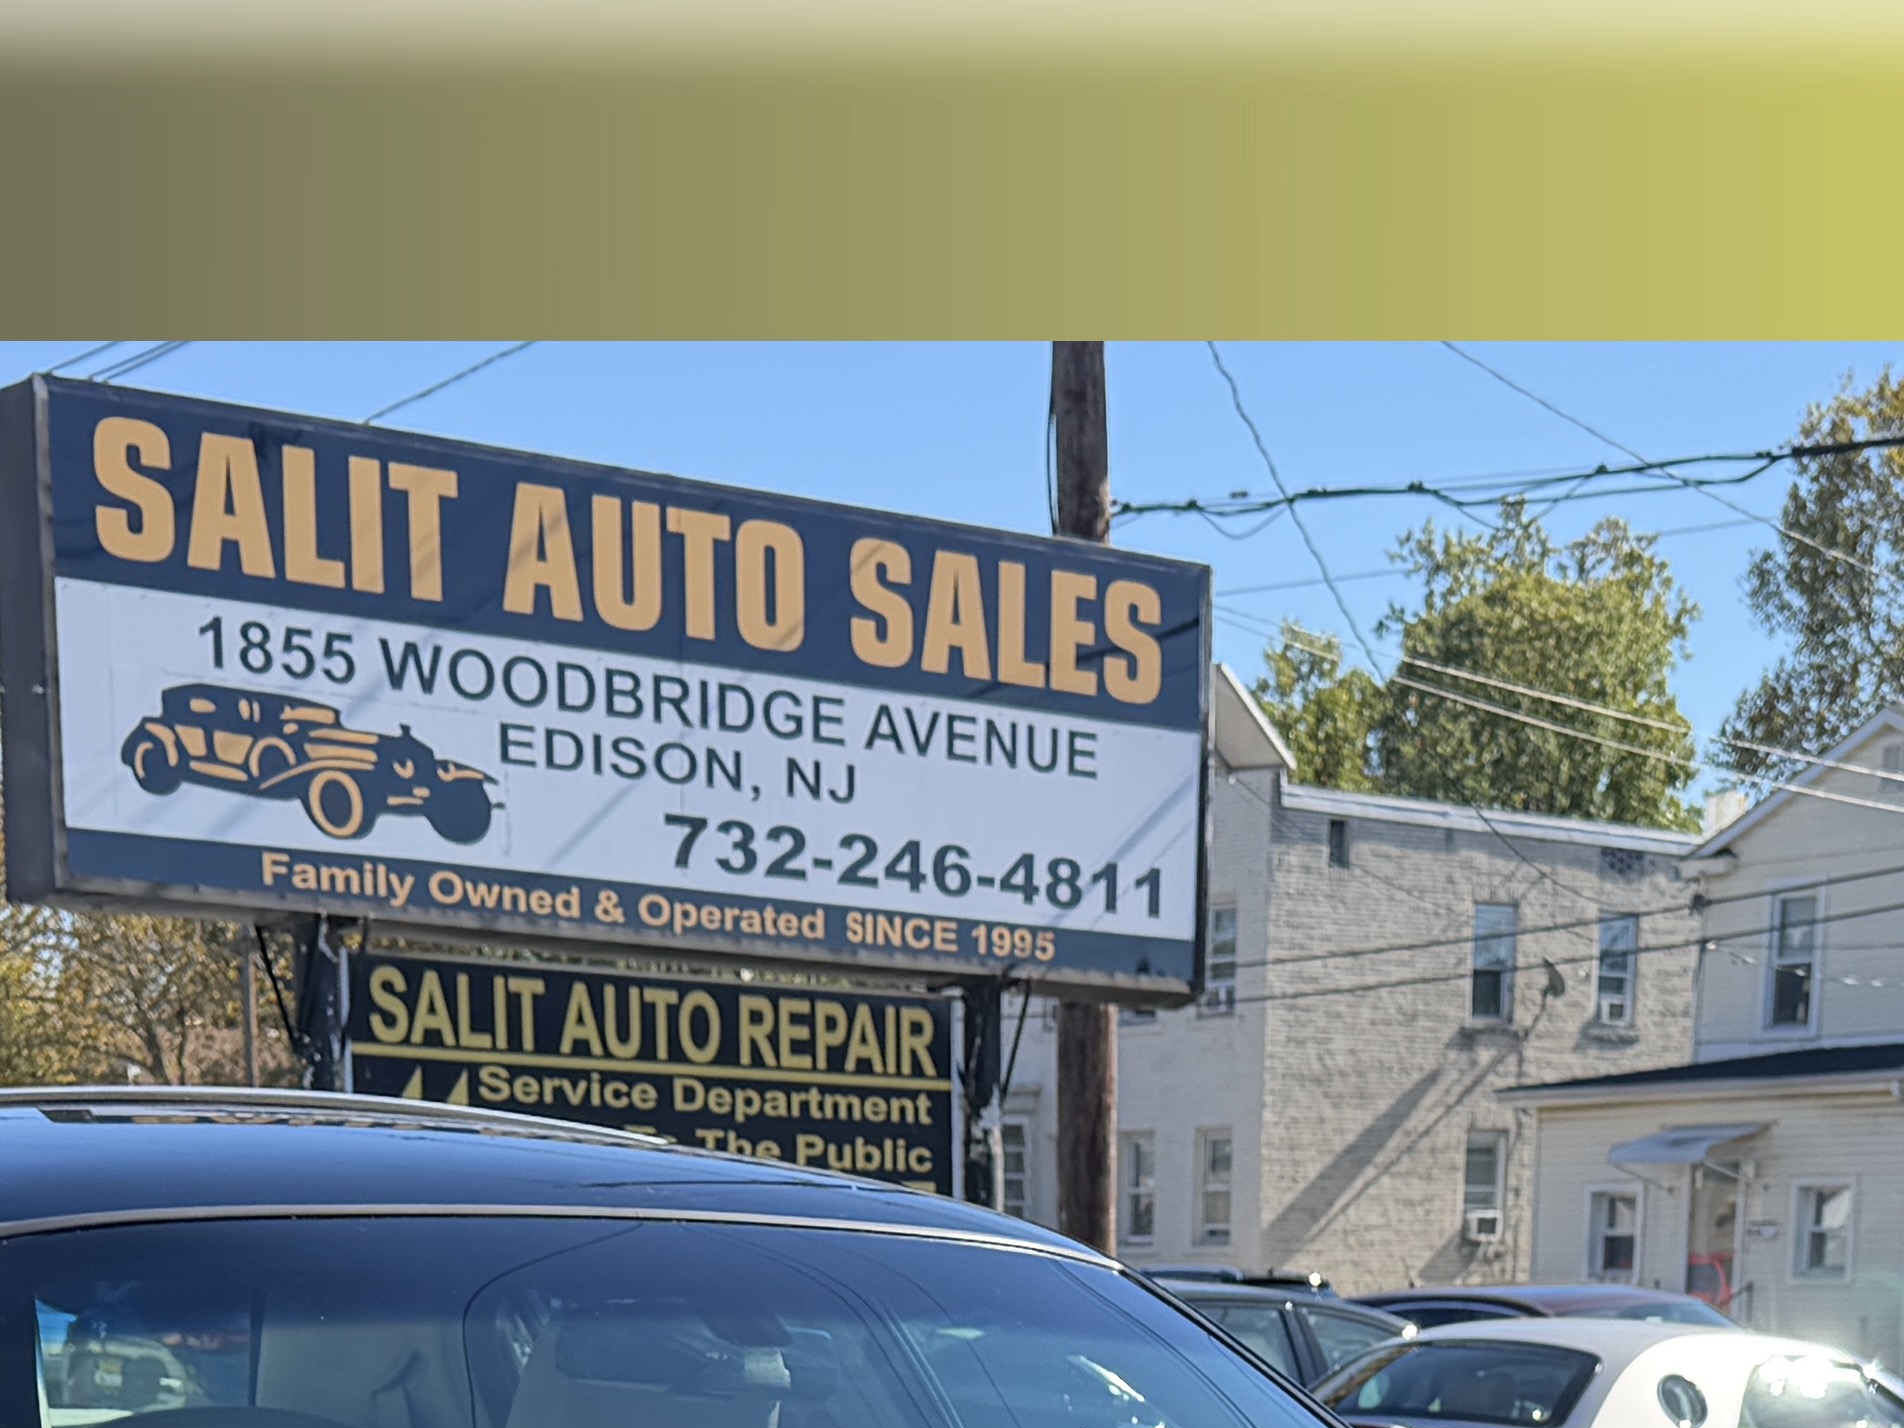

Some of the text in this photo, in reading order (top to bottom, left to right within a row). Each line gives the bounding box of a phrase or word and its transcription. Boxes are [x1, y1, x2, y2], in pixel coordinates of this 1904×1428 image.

[93, 416, 1162, 704] SALIT AUTO SALES
[198, 615, 1099, 780] 1855 WOODBRIDGE AVENUE
[499, 721, 856, 804] EDISON, NJ
[261, 852, 1056, 961] Family Owned & Operated SINCE 1995
[663, 813, 1162, 919] 732-246-4811
[369, 965, 937, 1077] SALIT AUTO REPAIR
[479, 1065, 658, 1110] Service
[672, 1078, 933, 1126] Department
[696, 1128, 782, 1160] The
[796, 1133, 933, 1173] Public
